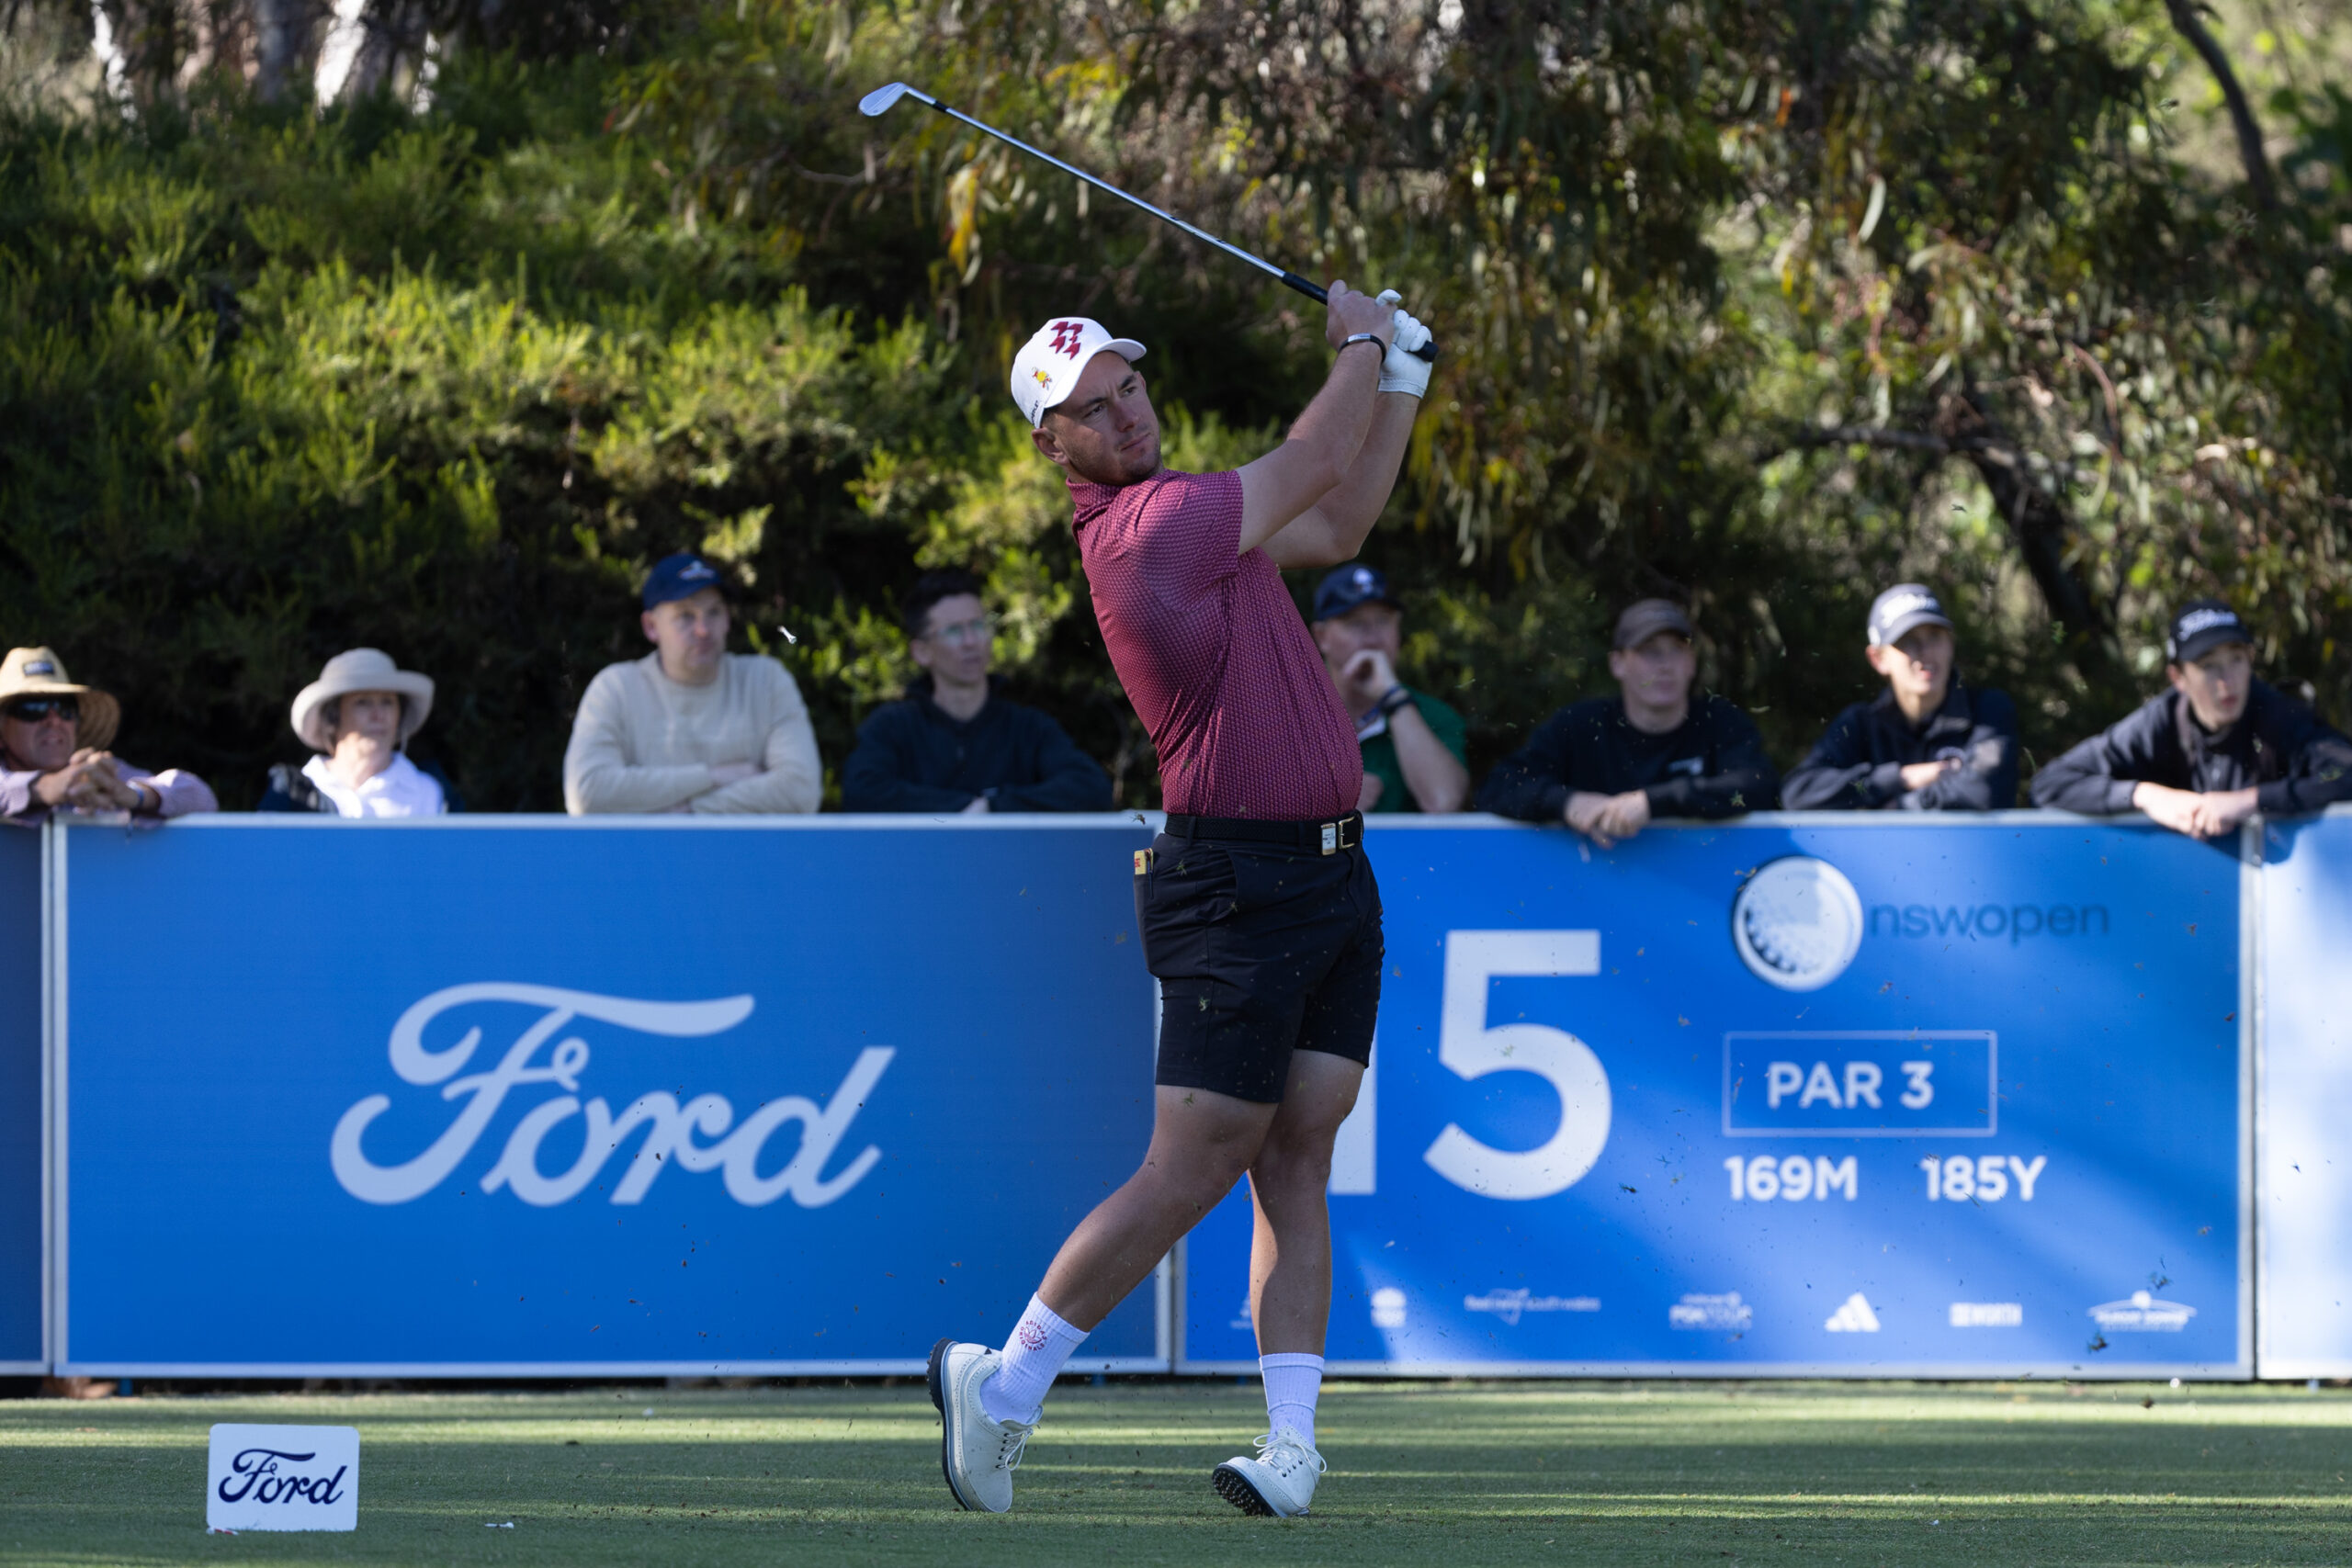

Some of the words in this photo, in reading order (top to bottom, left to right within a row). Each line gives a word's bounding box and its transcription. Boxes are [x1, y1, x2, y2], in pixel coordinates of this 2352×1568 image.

[1869, 902, 2110, 947] nswopen
[331, 982, 894, 1207] Ford
[1767, 1062, 1883, 1109] PAR
[1901, 1062, 1935, 1109] 3
[1724, 1156, 1858, 1201] 169M
[1921, 1156, 2047, 1201] 185Y
[218, 1448, 347, 1506] Ford
